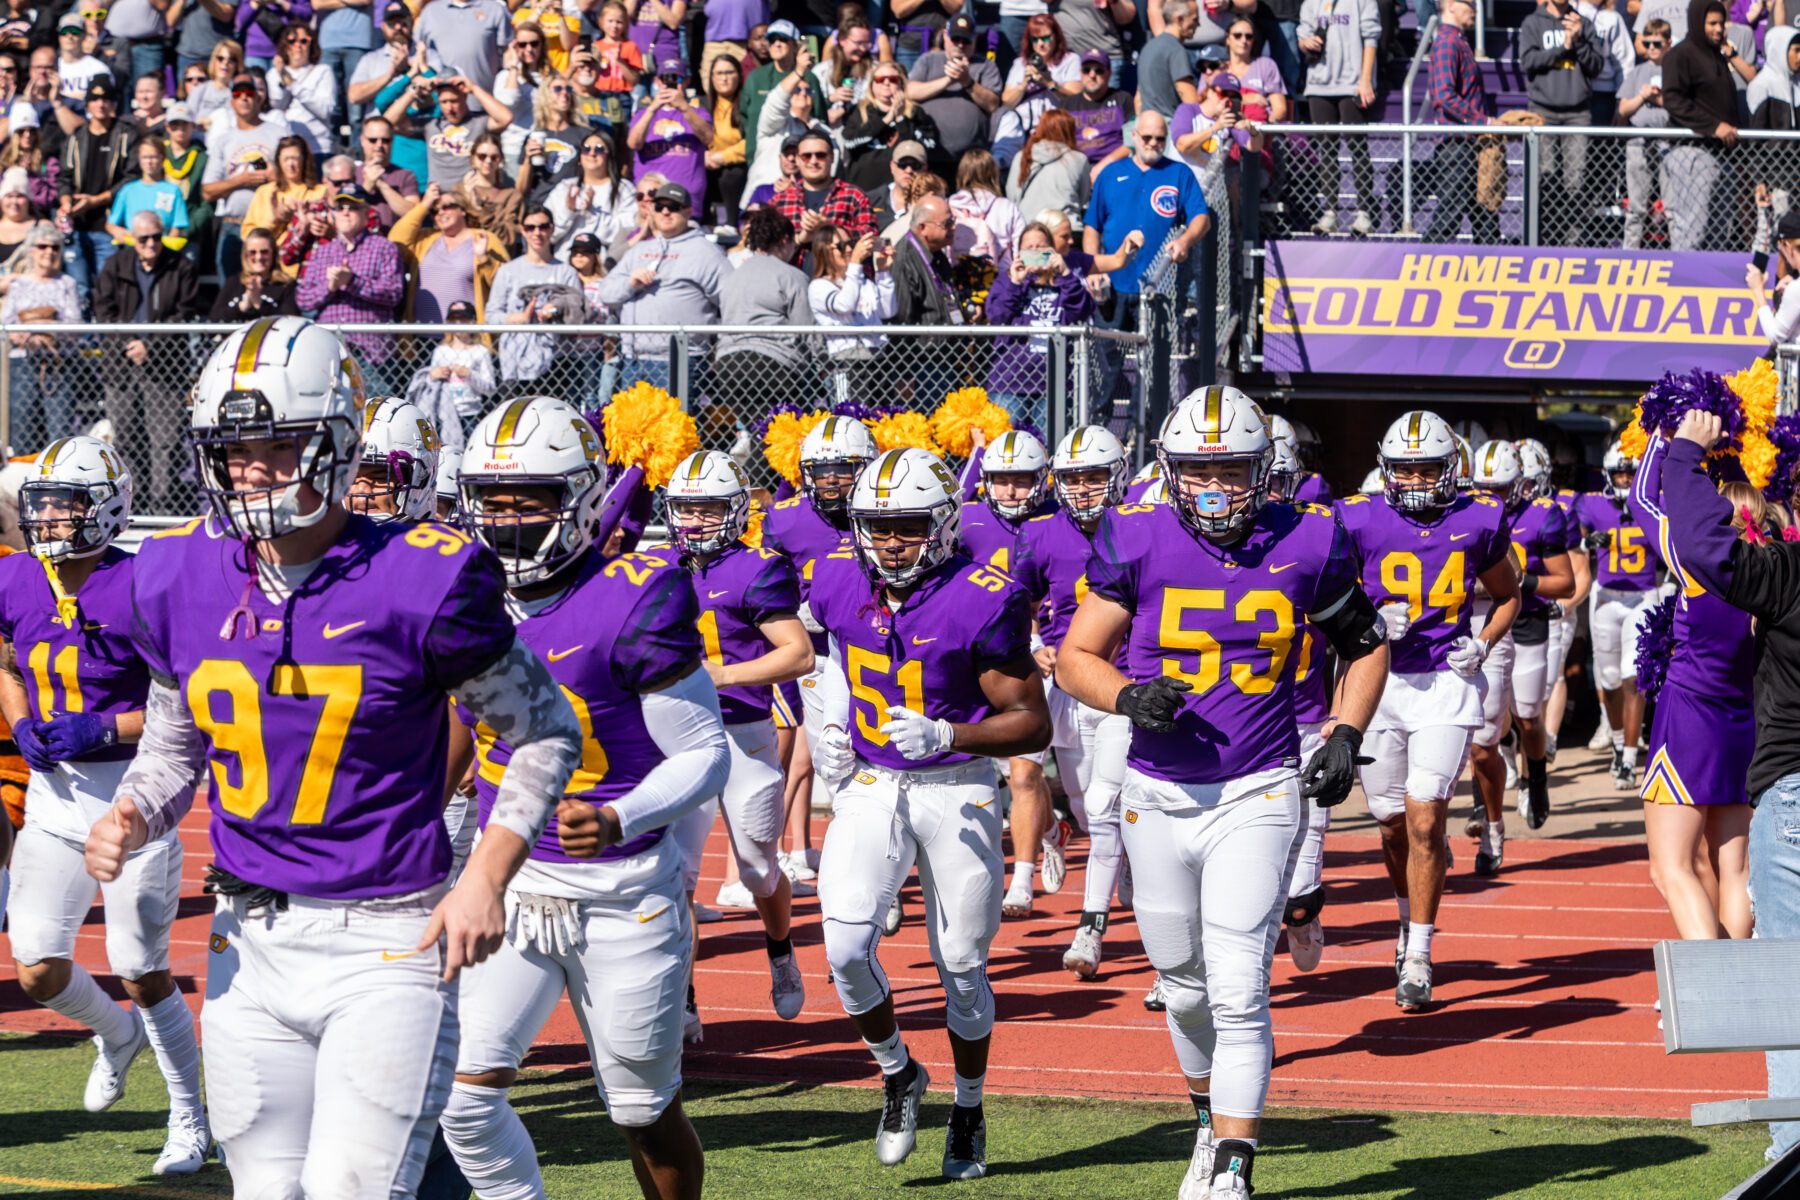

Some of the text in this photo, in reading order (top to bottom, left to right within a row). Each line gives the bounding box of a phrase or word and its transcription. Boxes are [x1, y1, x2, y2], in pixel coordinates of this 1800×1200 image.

[1399, 254, 1674, 287] HOME OF THE
[1269, 286, 1767, 337] GOLD STANDAR
[1380, 552, 1467, 624] 94
[1608, 527, 1645, 573] 15
[1159, 587, 1295, 695] 53
[28, 641, 84, 722] 11
[847, 643, 925, 747] 51
[187, 659, 363, 825] 97
